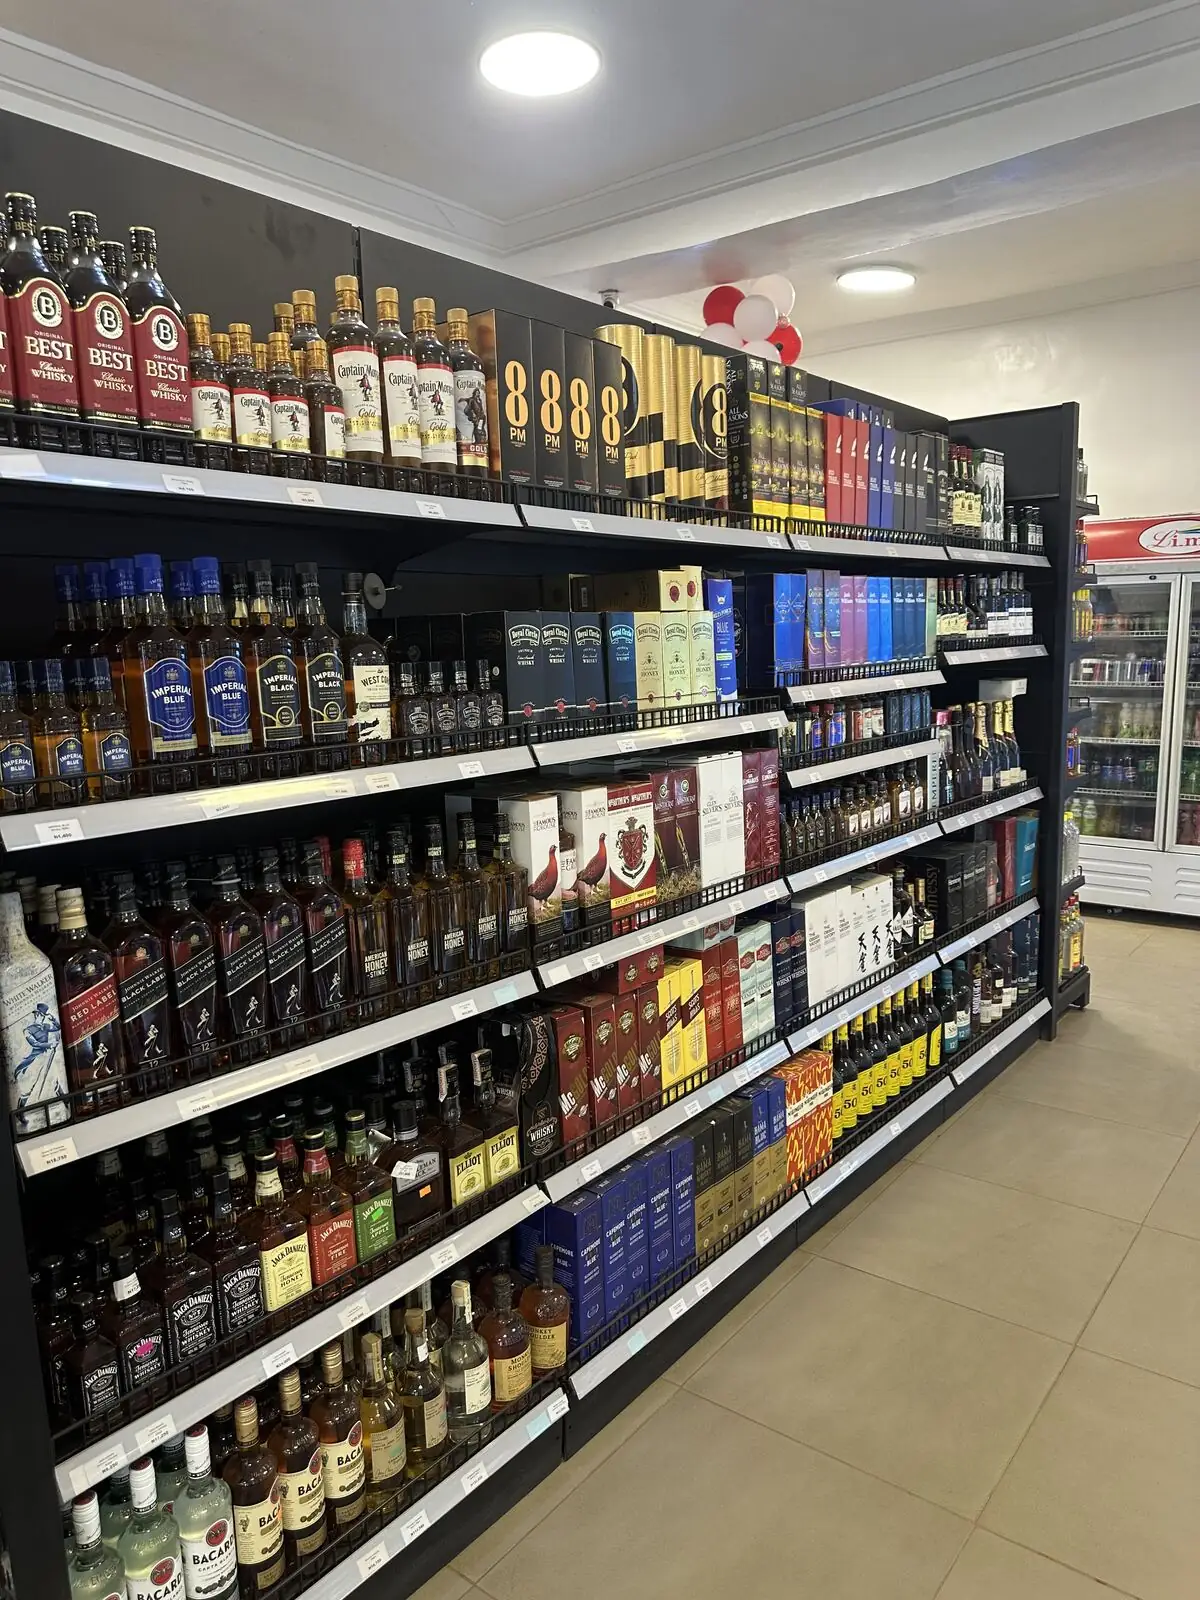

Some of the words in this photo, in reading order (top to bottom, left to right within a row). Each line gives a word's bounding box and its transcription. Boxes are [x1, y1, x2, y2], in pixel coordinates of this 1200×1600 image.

[34, 330, 64, 340] ORIGINAL
[24, 335, 73, 360] BEST
[97, 342, 124, 352] ORIGINAL
[88, 347, 133, 371] BEST
[153, 354, 178, 363] ORIGINAL
[39, 361, 66, 373] Classic
[145, 359, 188, 382] BEST
[337, 363, 364, 380] Captain
[31, 368, 74, 383] WHISKY
[102, 372, 125, 383] Classic
[388, 372, 411, 387] Captain
[94, 379, 134, 393] WHISKY
[158, 382, 180, 393] Classic
[151, 389, 188, 402] WHISKY
[505, 360, 528, 427] 8
[540, 369, 563, 434] 8
[570, 377, 591, 439] 8
[274, 403, 293, 416] Captain
[358, 407, 376, 419] Gold
[601, 385, 620, 446] 8
[711, 388, 727, 437] 8
[429, 421, 447, 433] Gold
[510, 427, 526, 441] PM
[545, 433, 560, 448] PM
[575, 439, 589, 453] PM
[605, 445, 619, 459] PM
[512, 628, 524, 640] Royal
[525, 628, 538, 639] Circle
[543, 629, 555, 638] Royal
[556, 628, 568, 638] Circle
[577, 630, 588, 639] Royal
[588, 629, 600, 639] Circle
[612, 628, 622, 638] Royal
[622, 628, 632, 637] Circle
[717, 622, 729, 633] BLUE
[263, 674, 297, 685] IMPERIAL
[312, 670, 344, 681] IMPERIAL
[361, 675, 381, 687] WEST
[210, 681, 248, 695] IMPERIAL
[270, 682, 295, 692] BLACK
[318, 679, 341, 688] BLACK
[151, 684, 192, 699] IMPERIAL
[221, 691, 242, 700] BLUE
[163, 694, 185, 704] BLUE
[509, 907, 528, 916] AMERICAN
[478, 914, 496, 924] AMERICAN
[509, 913, 528, 926] HONEY
[478, 920, 497, 934] HONEY
[444, 930, 464, 941] AMERICAN
[311, 939, 331, 954] BLACK
[407, 940, 429, 952] AMERICAN
[444, 936, 465, 950] HONEY
[268, 949, 289, 965] BLACK
[364, 951, 388, 963] AMERICAN
[407, 946, 429, 961] HONEY
[226, 961, 247, 976] BLACK
[364, 958, 388, 973] HONEY
[176, 972, 198, 988] BLACK
[3, 992, 28, 1007] WHITE
[27, 973, 53, 992] WALKER
[121, 985, 145, 1003] BLACK
[70, 1008, 89, 1022] RED
[91, 989, 116, 1009] LABEL
[200, 1043, 210, 1052] 12
[844, 1097, 858, 1109] 50
[530, 1125, 554, 1142] WHISKY
[490, 1134, 516, 1157] ELLIOT
[456, 1153, 482, 1176] ELLIOT
[362, 1204, 374, 1220] JACK
[320, 1227, 333, 1242] JACK
[333, 1219, 353, 1231] DANIEL'S
[371, 1226, 389, 1240] APPLE
[271, 1251, 286, 1268] JACK
[285, 1243, 307, 1256] DANIEL'S
[331, 1250, 346, 1260] FIRE
[223, 1275, 238, 1292] JACK
[238, 1266, 261, 1279] DANIEL'S
[280, 1272, 304, 1288] HONEY
[173, 1301, 189, 1320] JACK
[188, 1292, 213, 1307] DANIEL'S
[233, 1293, 257, 1308] Tennessee
[231, 1299, 259, 1317] WHISKEY
[181, 1327, 211, 1345] WHISKEY
[182, 1321, 209, 1337] Tennessee
[127, 1346, 140, 1359] JACK
[85, 1374, 98, 1388] JACK
[98, 1366, 117, 1377] DANIEL'S
[134, 1363, 161, 1379] WHISKEY
[192, 1534, 234, 1565] BACARD
[137, 1572, 182, 1600] BACARD
